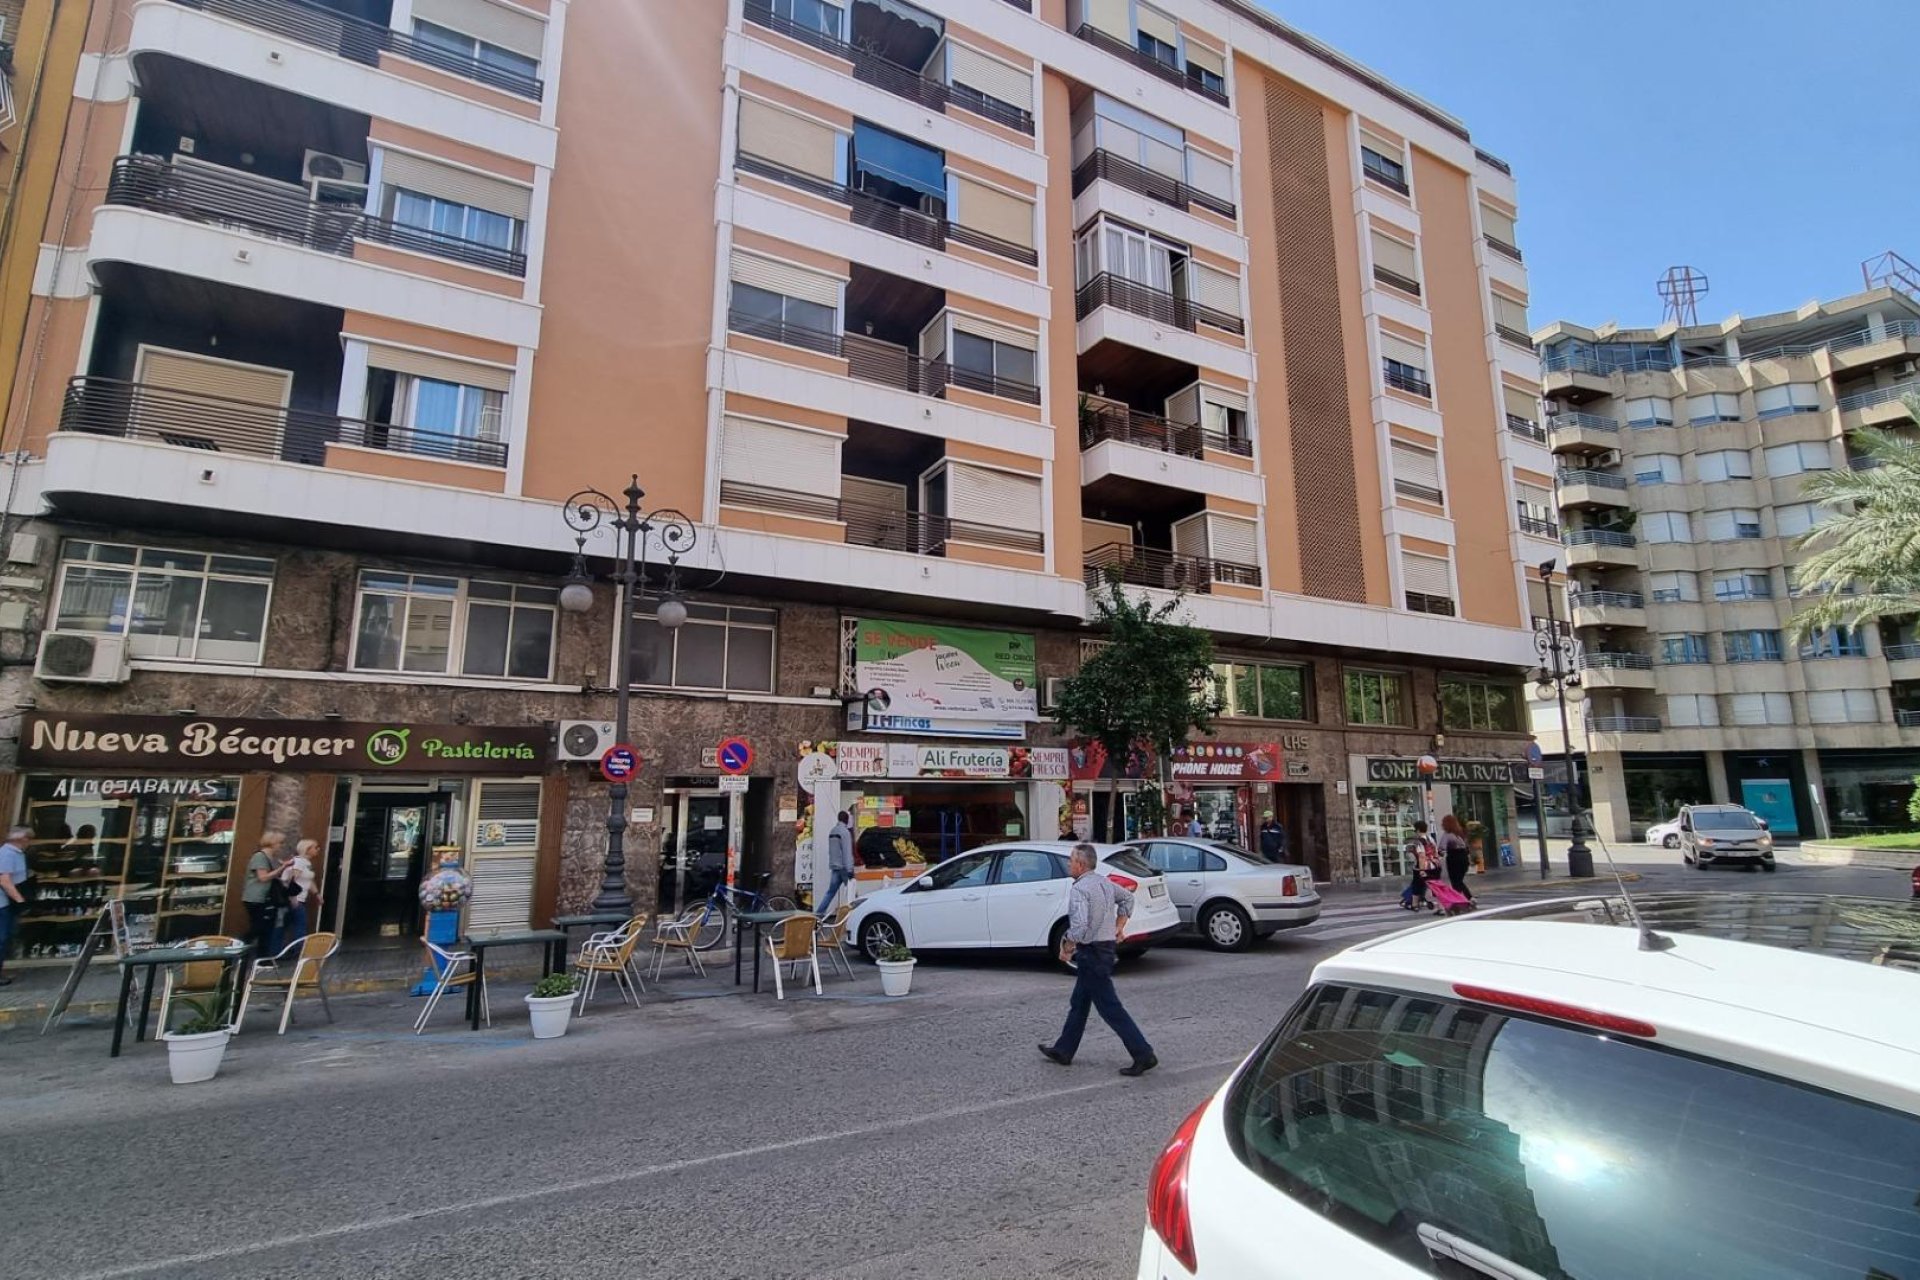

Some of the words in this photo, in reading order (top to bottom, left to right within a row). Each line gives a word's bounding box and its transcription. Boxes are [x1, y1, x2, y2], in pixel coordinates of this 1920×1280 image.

[864, 631, 881, 646] SE
[887, 633, 938, 651] VENDE
[30, 719, 168, 752] Nueva
[179, 722, 355, 764] Bécquer
[421, 738, 535, 760] Pastelería
[923, 750, 946, 766] Ali
[949, 750, 1003, 767] Frutería
[1032, 751, 1066, 762] SIEMPRE
[1032, 763, 1067, 775] FRESCA
[1173, 762, 1208, 775] PHONE
[1209, 763, 1243, 775] HOUSE
[1472, 763, 1507, 780] RUIZ
